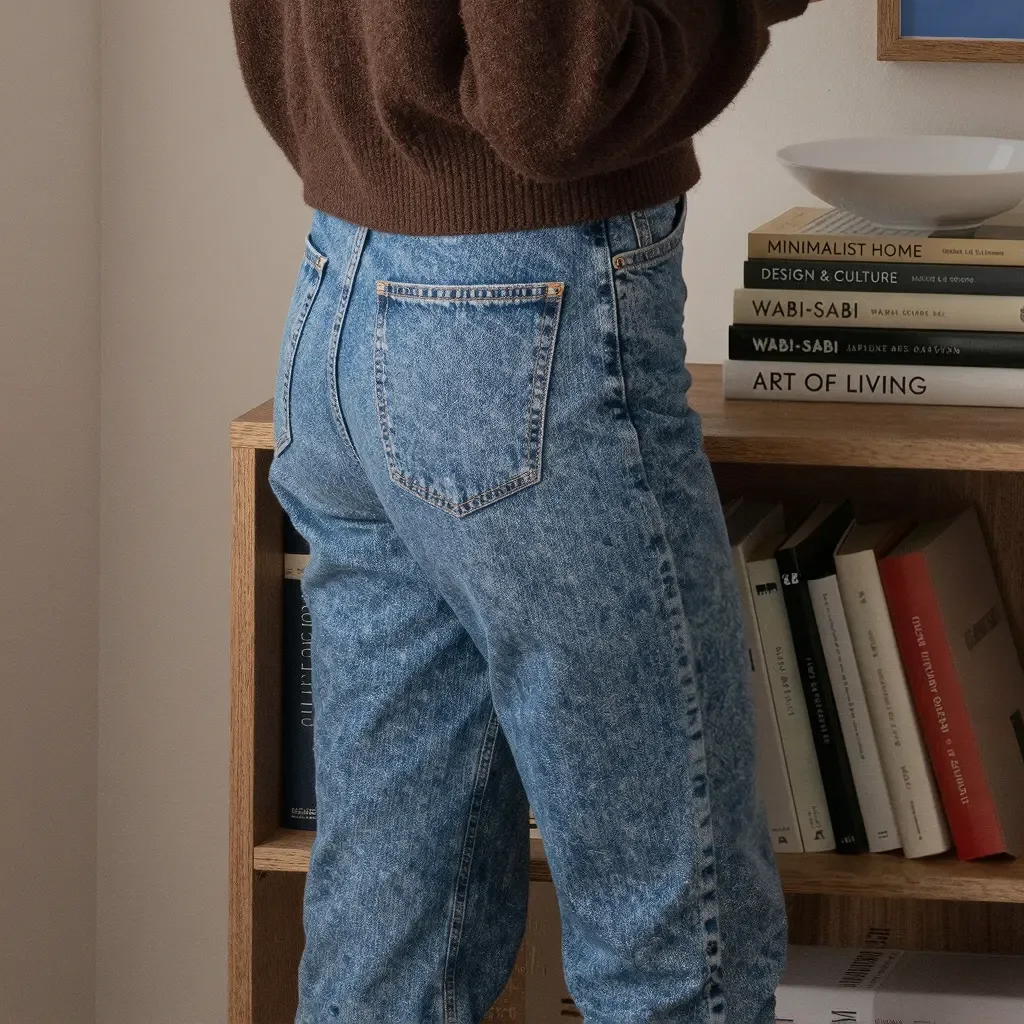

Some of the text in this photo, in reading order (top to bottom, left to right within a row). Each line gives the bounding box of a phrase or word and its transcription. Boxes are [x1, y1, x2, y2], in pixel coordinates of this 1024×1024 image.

[767, 239, 866, 257] MINIMALIST
[872, 243, 922, 258] HOME
[761, 267, 815, 281] DESIGN
[820, 269, 830, 282] &
[834, 270, 898, 284] CULTURE
[751, 299, 858, 319] WABI-SABI
[752, 337, 838, 354] WABI-SABI
[752, 371, 927, 395] ART OF LIVING
